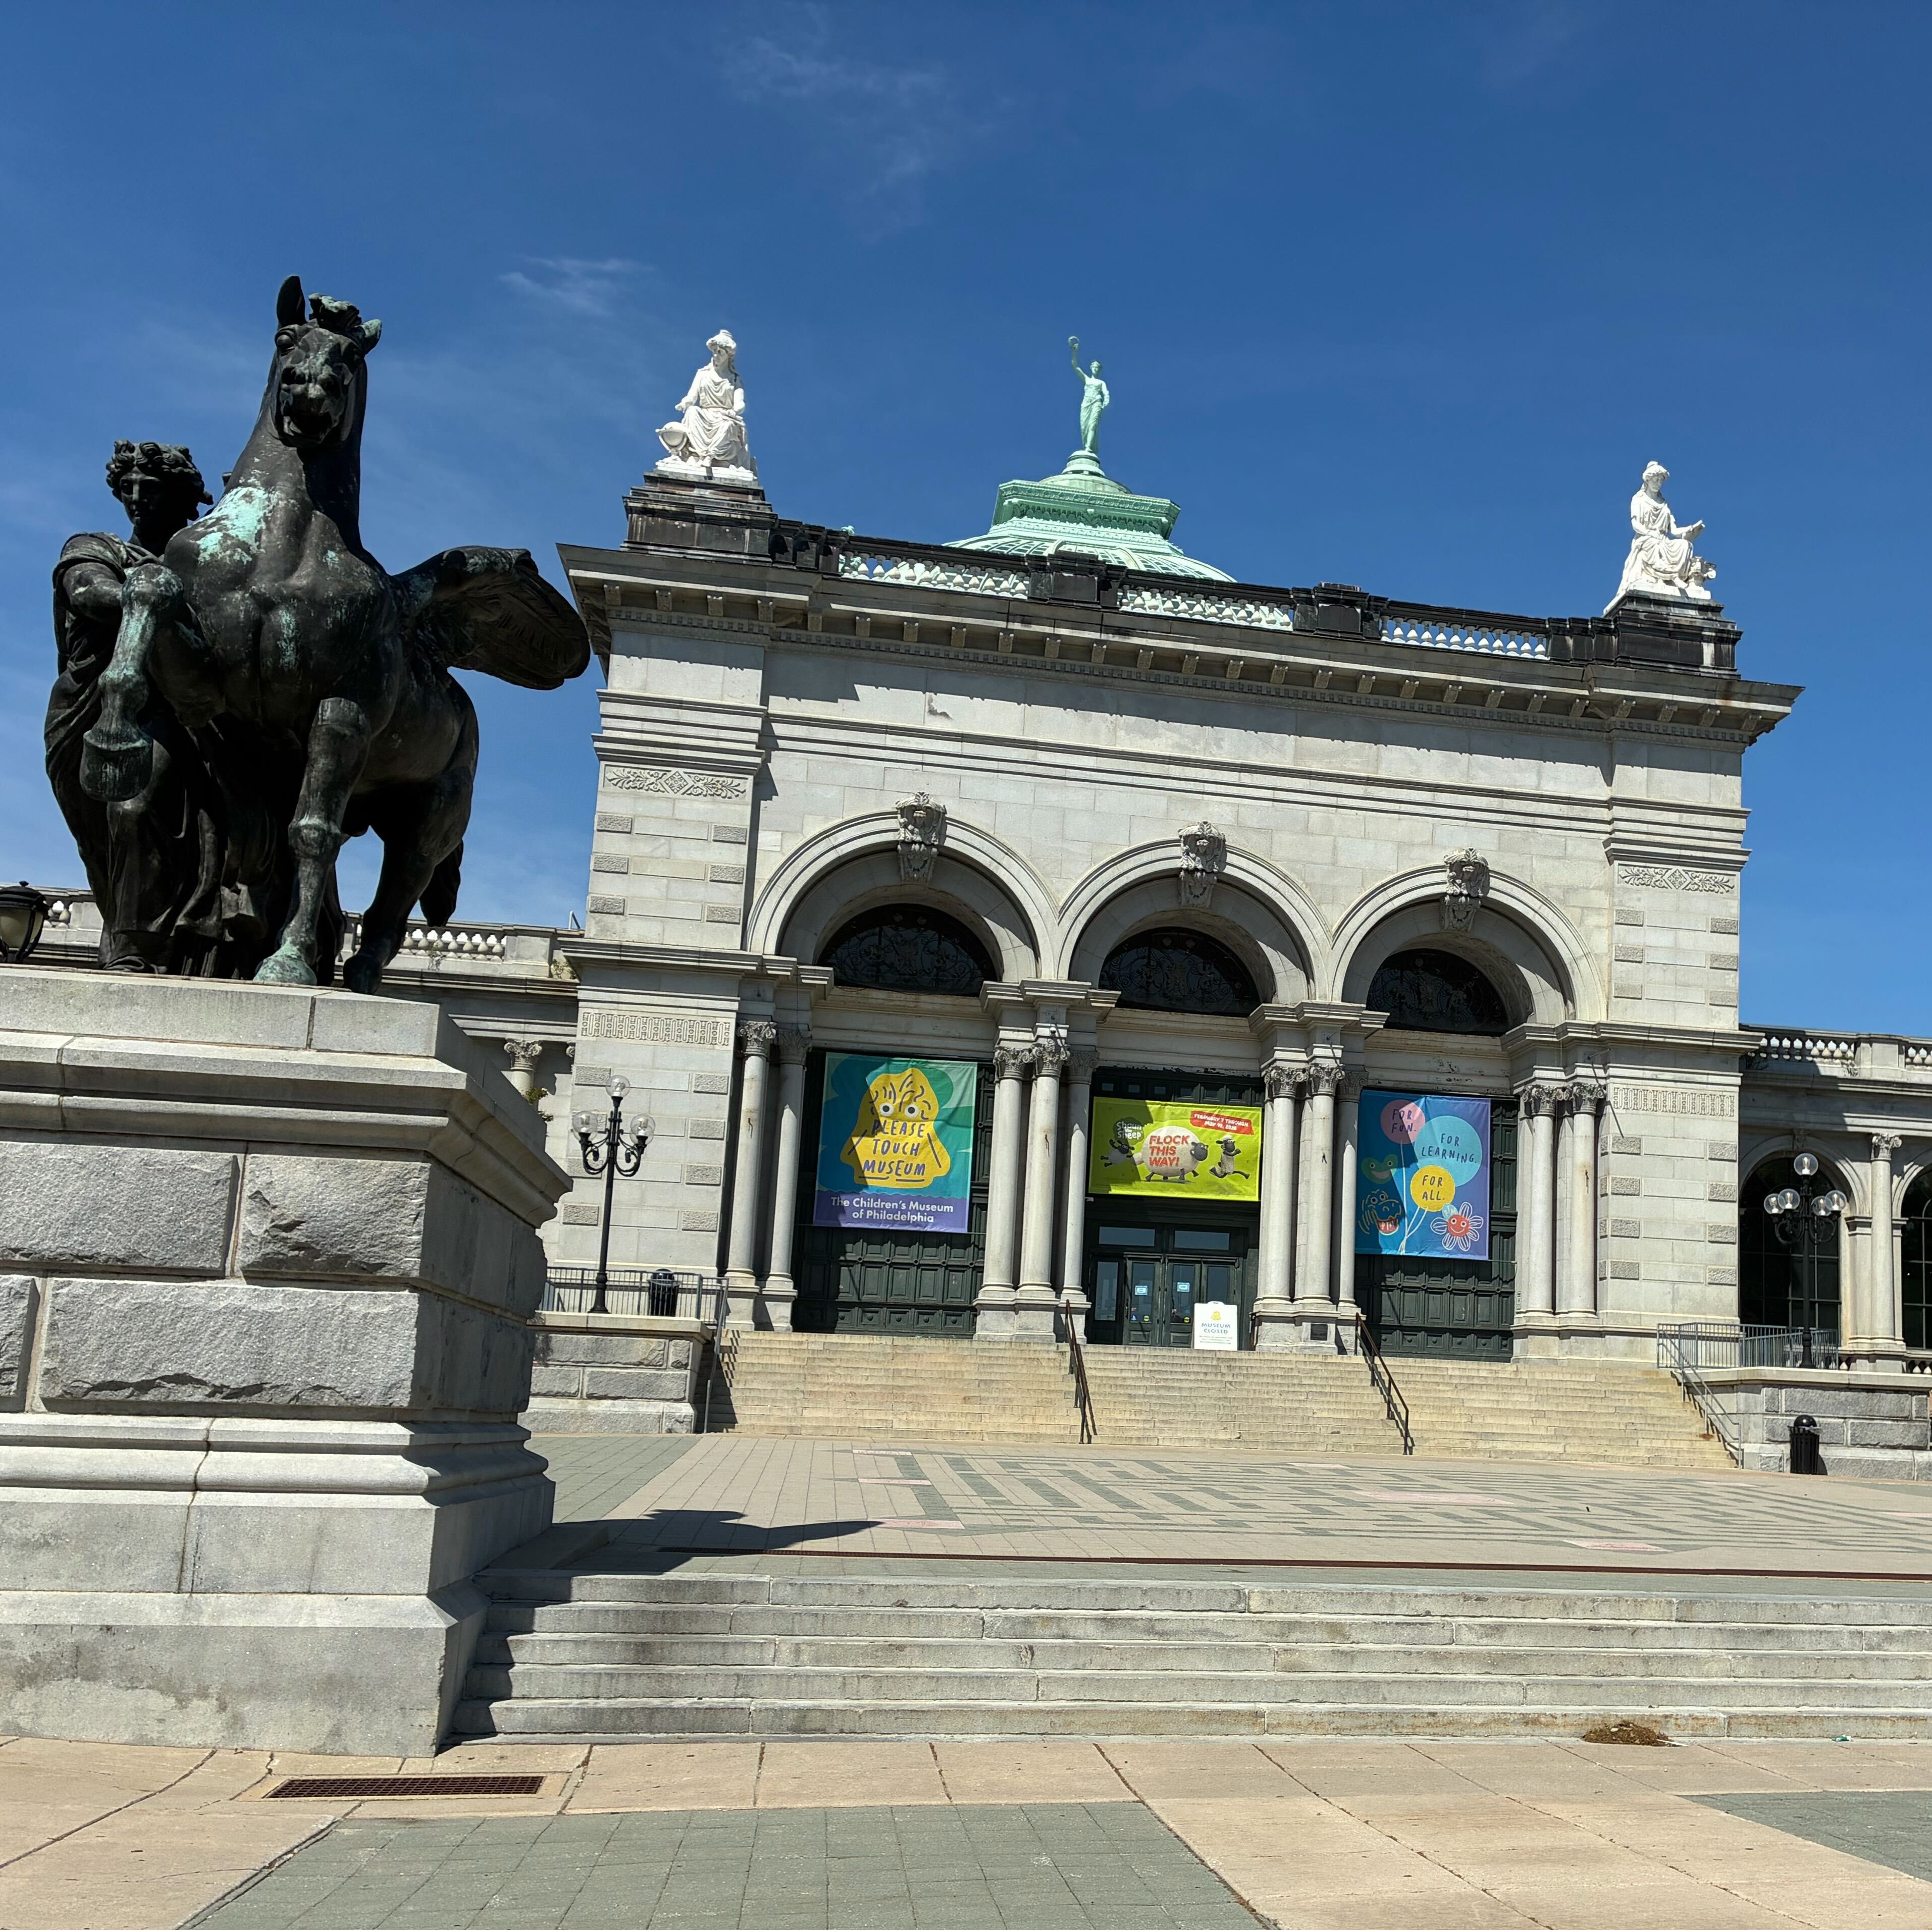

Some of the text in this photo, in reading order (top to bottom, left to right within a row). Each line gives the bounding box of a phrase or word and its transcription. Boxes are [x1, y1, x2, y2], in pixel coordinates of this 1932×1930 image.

[1194, 1113, 1220, 1122] FEBRUARY
[1225, 1118, 1249, 1127] THROUGH
[1392, 1109, 1413, 1120] FOR
[871, 1119, 925, 1138] PLEASE
[1116, 1121, 1142, 1131] Shaun
[1391, 1123, 1417, 1133] FUN.
[1117, 1131, 1141, 1140] Sheep
[1149, 1135, 1190, 1145] FLOCK
[1441, 1133, 1459, 1147] FOR
[872, 1139, 920, 1156] TOUCH
[1149, 1146, 1177, 1156] THIS
[1421, 1146, 1477, 1163] LEARNING.
[862, 1159, 926, 1177] MUSEUM
[1149, 1156, 1180, 1167] WAY!
[1422, 1174, 1443, 1188] FOR
[1422, 1189, 1445, 1201] ALL.
[831, 1197, 954, 1212] The Children's Museum
[852, 1209, 934, 1223] of Philadelphia
